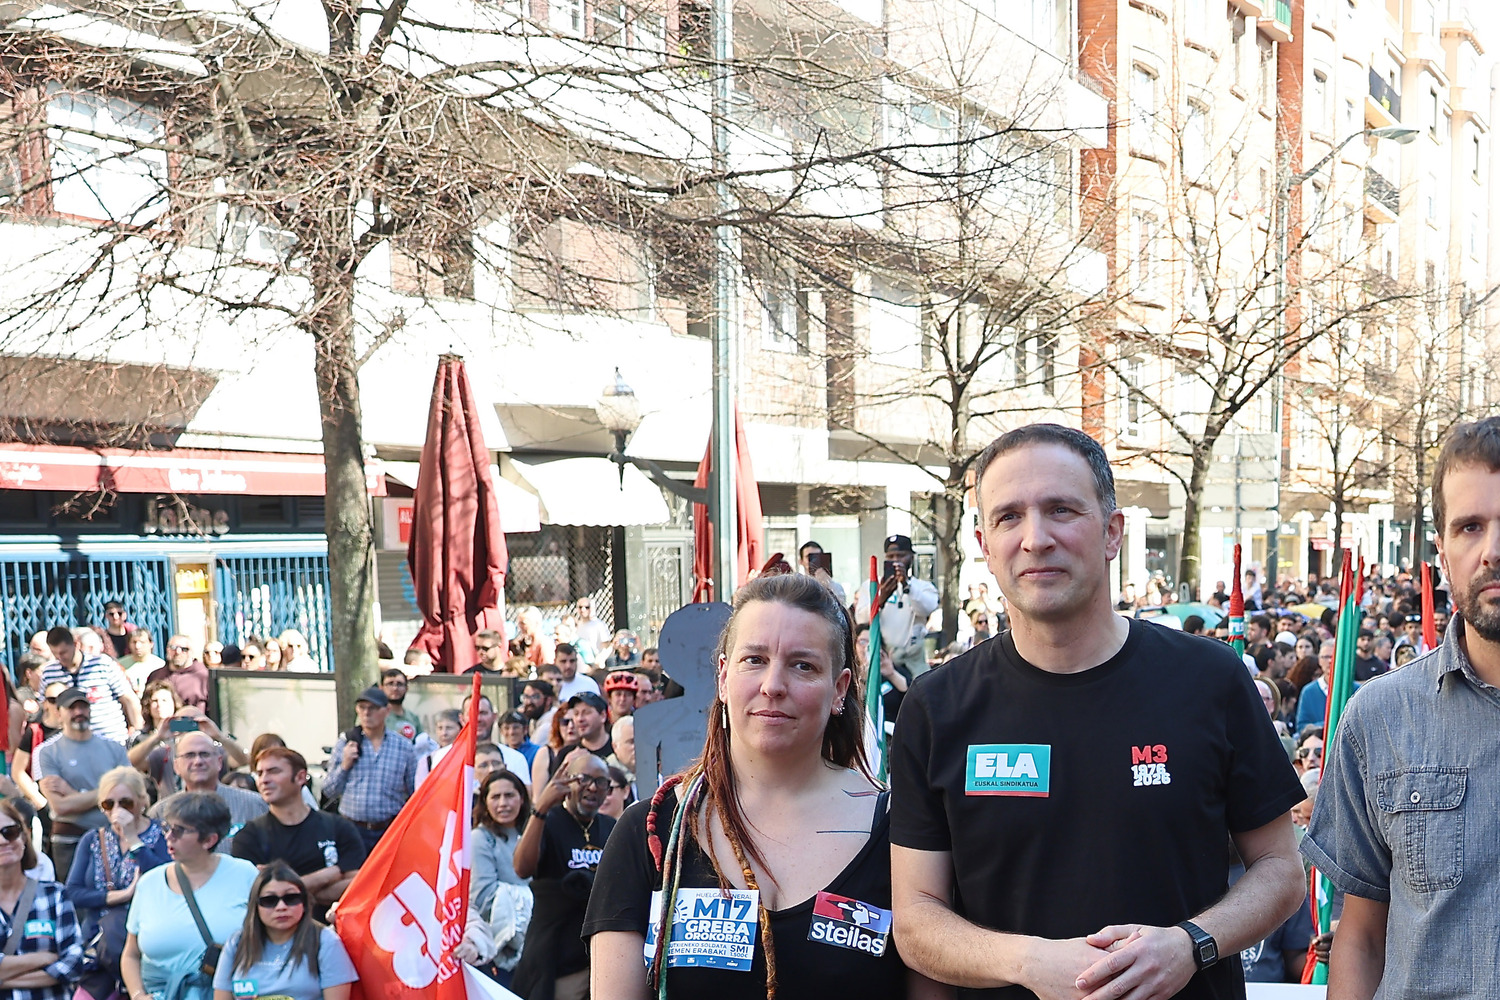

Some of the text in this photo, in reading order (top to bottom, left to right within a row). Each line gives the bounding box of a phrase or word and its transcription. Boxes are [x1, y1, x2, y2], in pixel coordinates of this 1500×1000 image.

[1131, 744, 1168, 765] M3
[975, 753, 1039, 778] ELA
[693, 898, 752, 920] M17
[685, 920, 750, 936] GREBA
[684, 932, 749, 944] OROKORRA
[811, 920, 884, 955] steilas
[693, 948, 727, 956] ERABAKI
[730, 945, 749, 954] SMI
